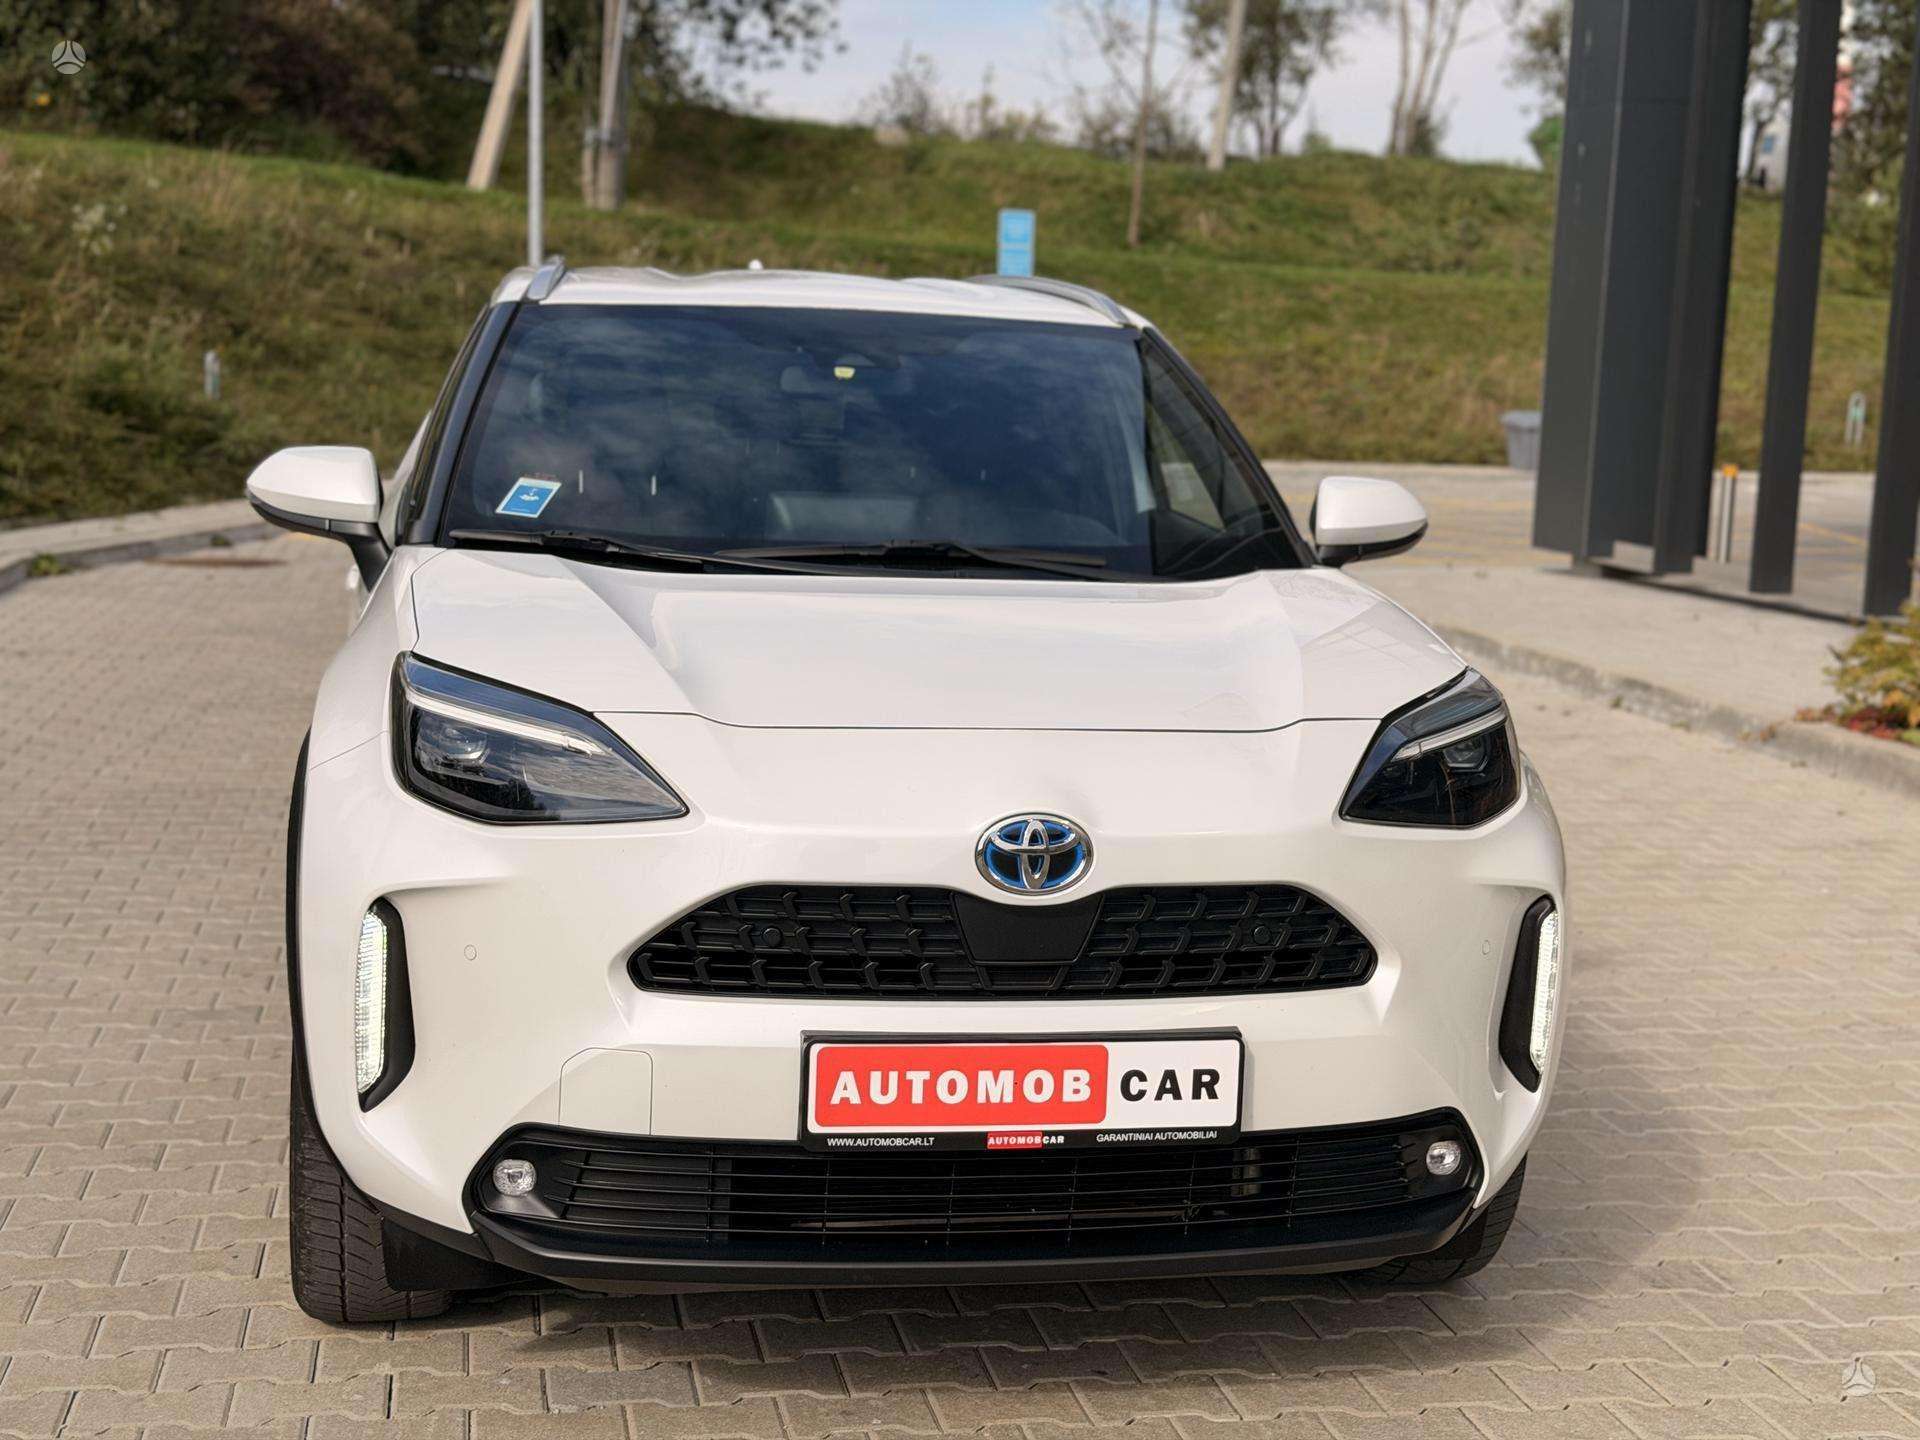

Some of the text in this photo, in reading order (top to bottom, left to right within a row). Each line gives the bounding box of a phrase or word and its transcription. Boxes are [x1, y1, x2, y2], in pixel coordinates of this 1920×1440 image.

[830, 1068, 1221, 1104] AUTOMOB CAR
[826, 1137, 935, 1147] WWW.AUTOMOBCAR.LT
[1096, 1131, 1218, 1143] GARANTINIAI AUTOMOBILIAI
